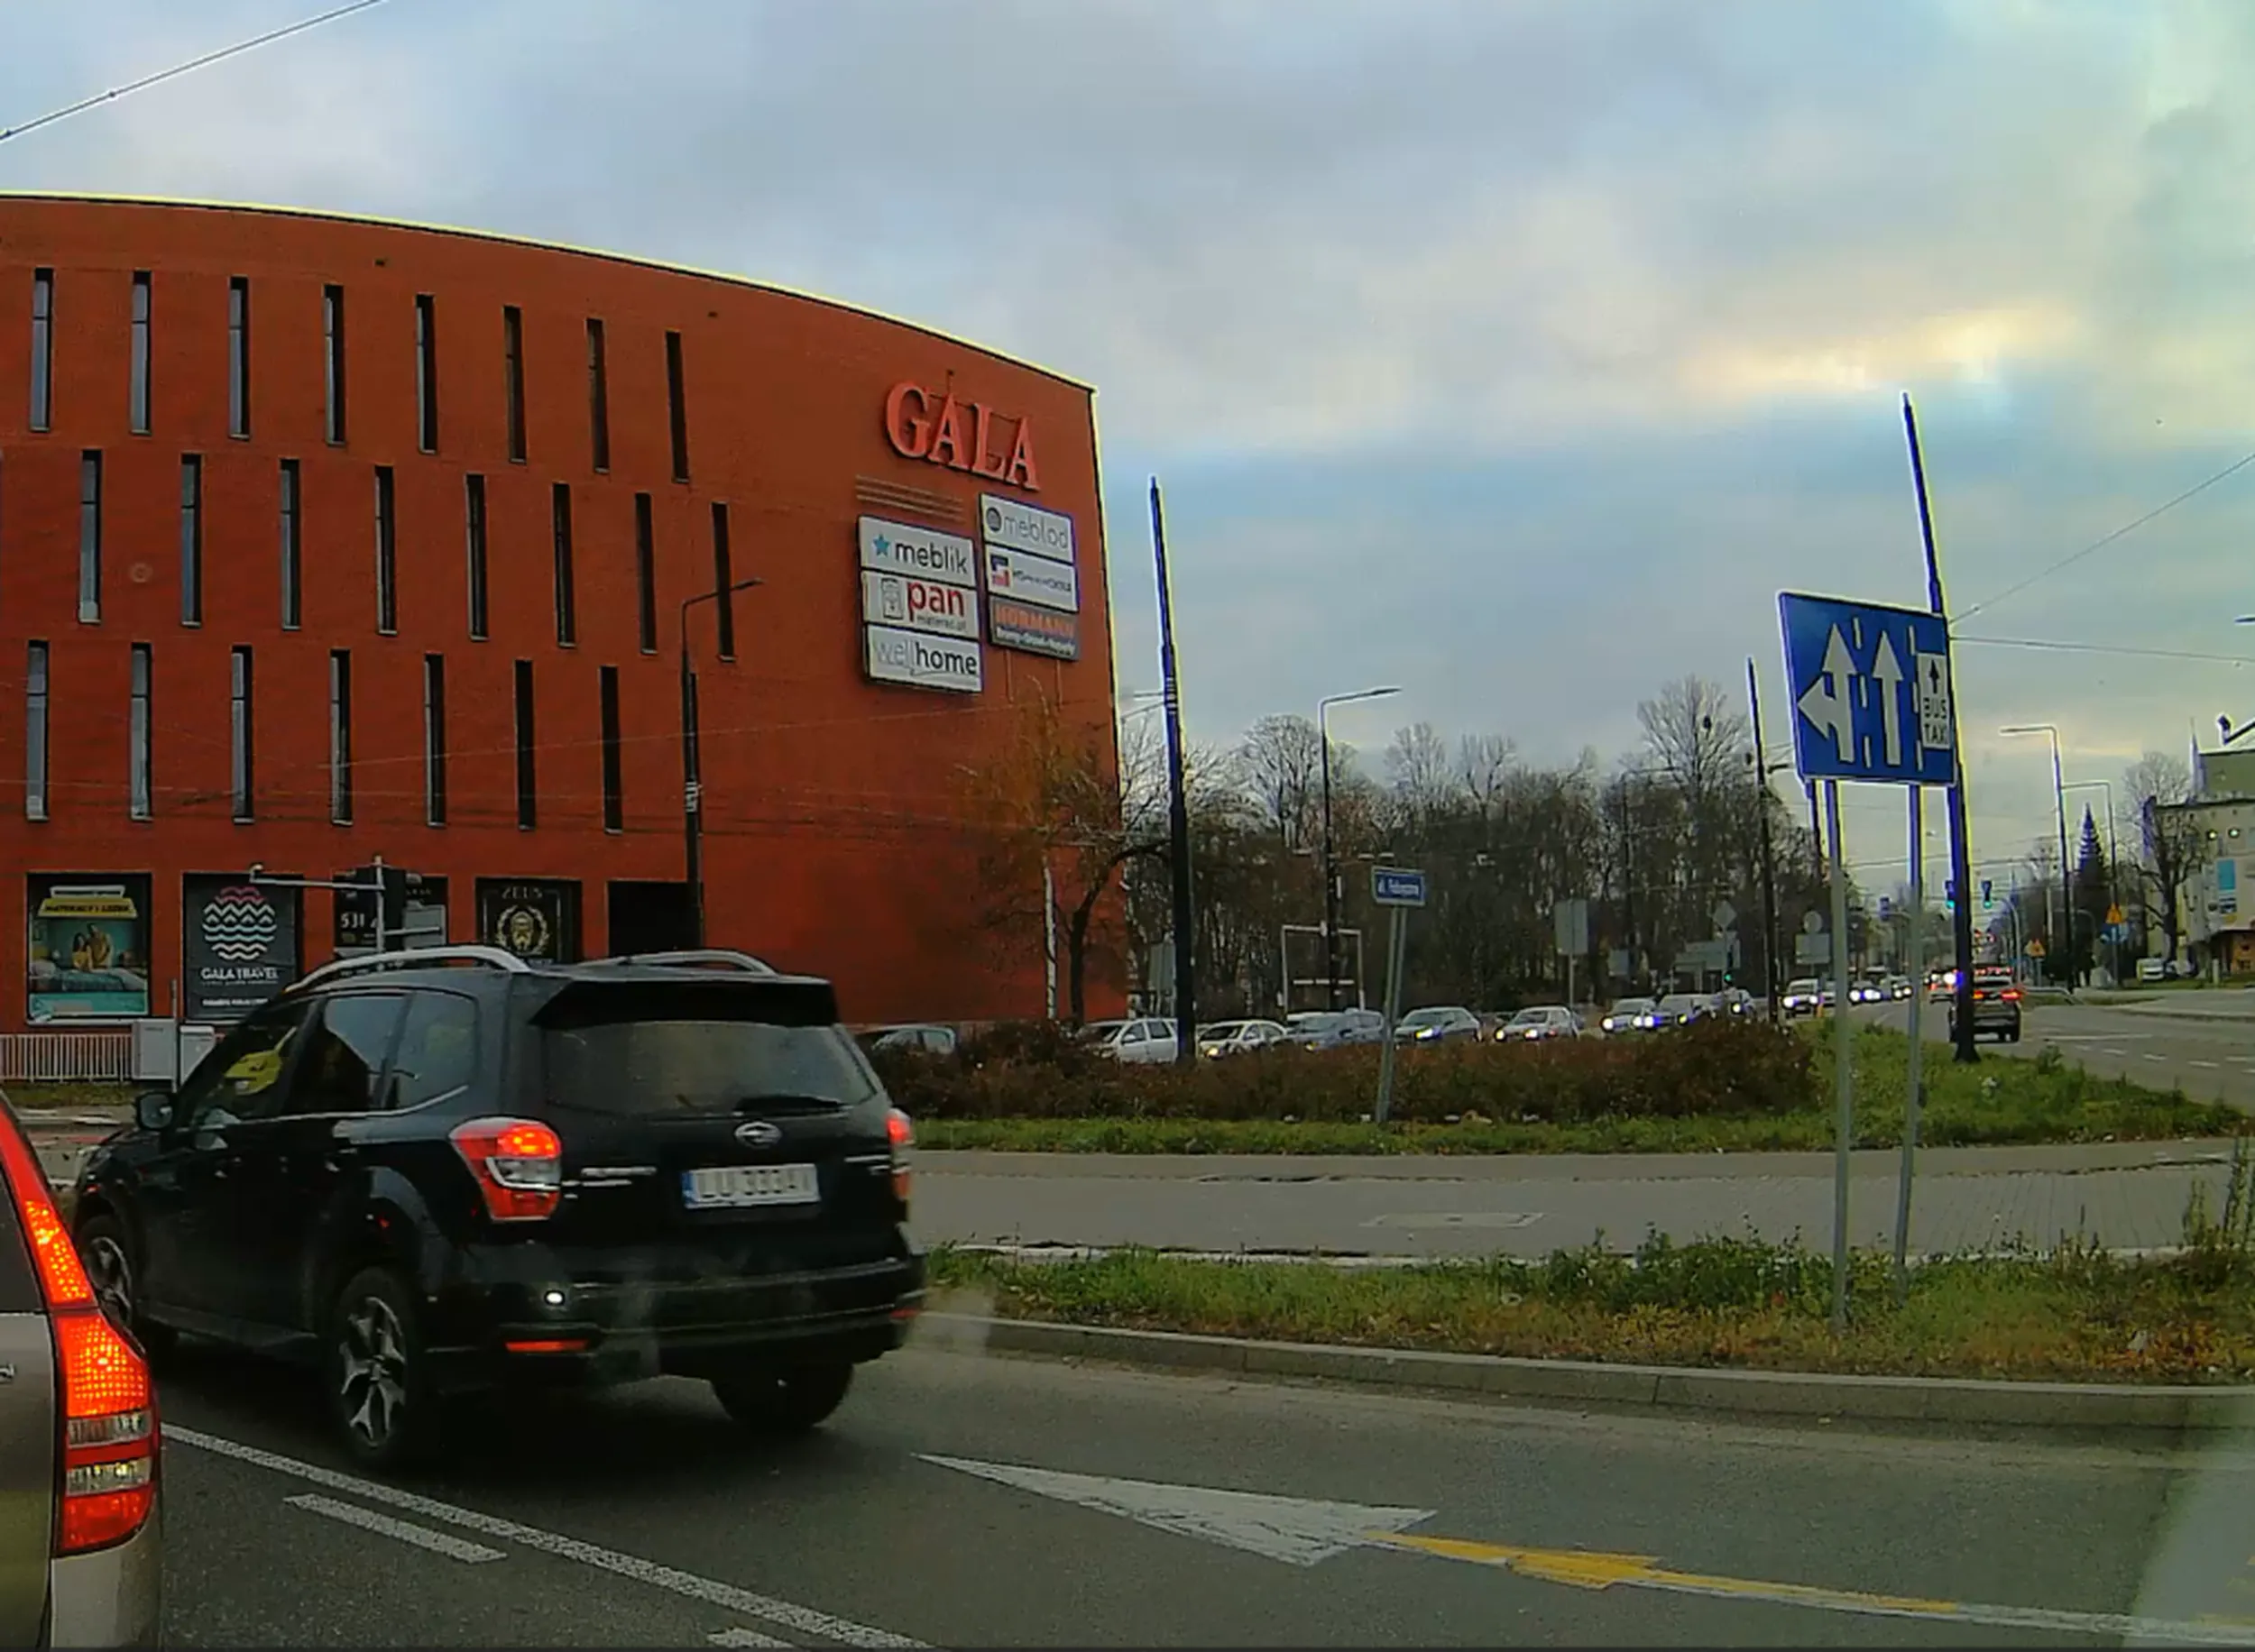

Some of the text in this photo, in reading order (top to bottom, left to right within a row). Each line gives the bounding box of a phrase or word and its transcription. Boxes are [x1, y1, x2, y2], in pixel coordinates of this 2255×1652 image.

[886, 381, 1040, 491] GALA
[895, 540, 969, 575] meblik
[907, 581, 965, 623] pan
[1923, 697, 1947, 720] BUS
[200, 967, 235, 980] GALA
